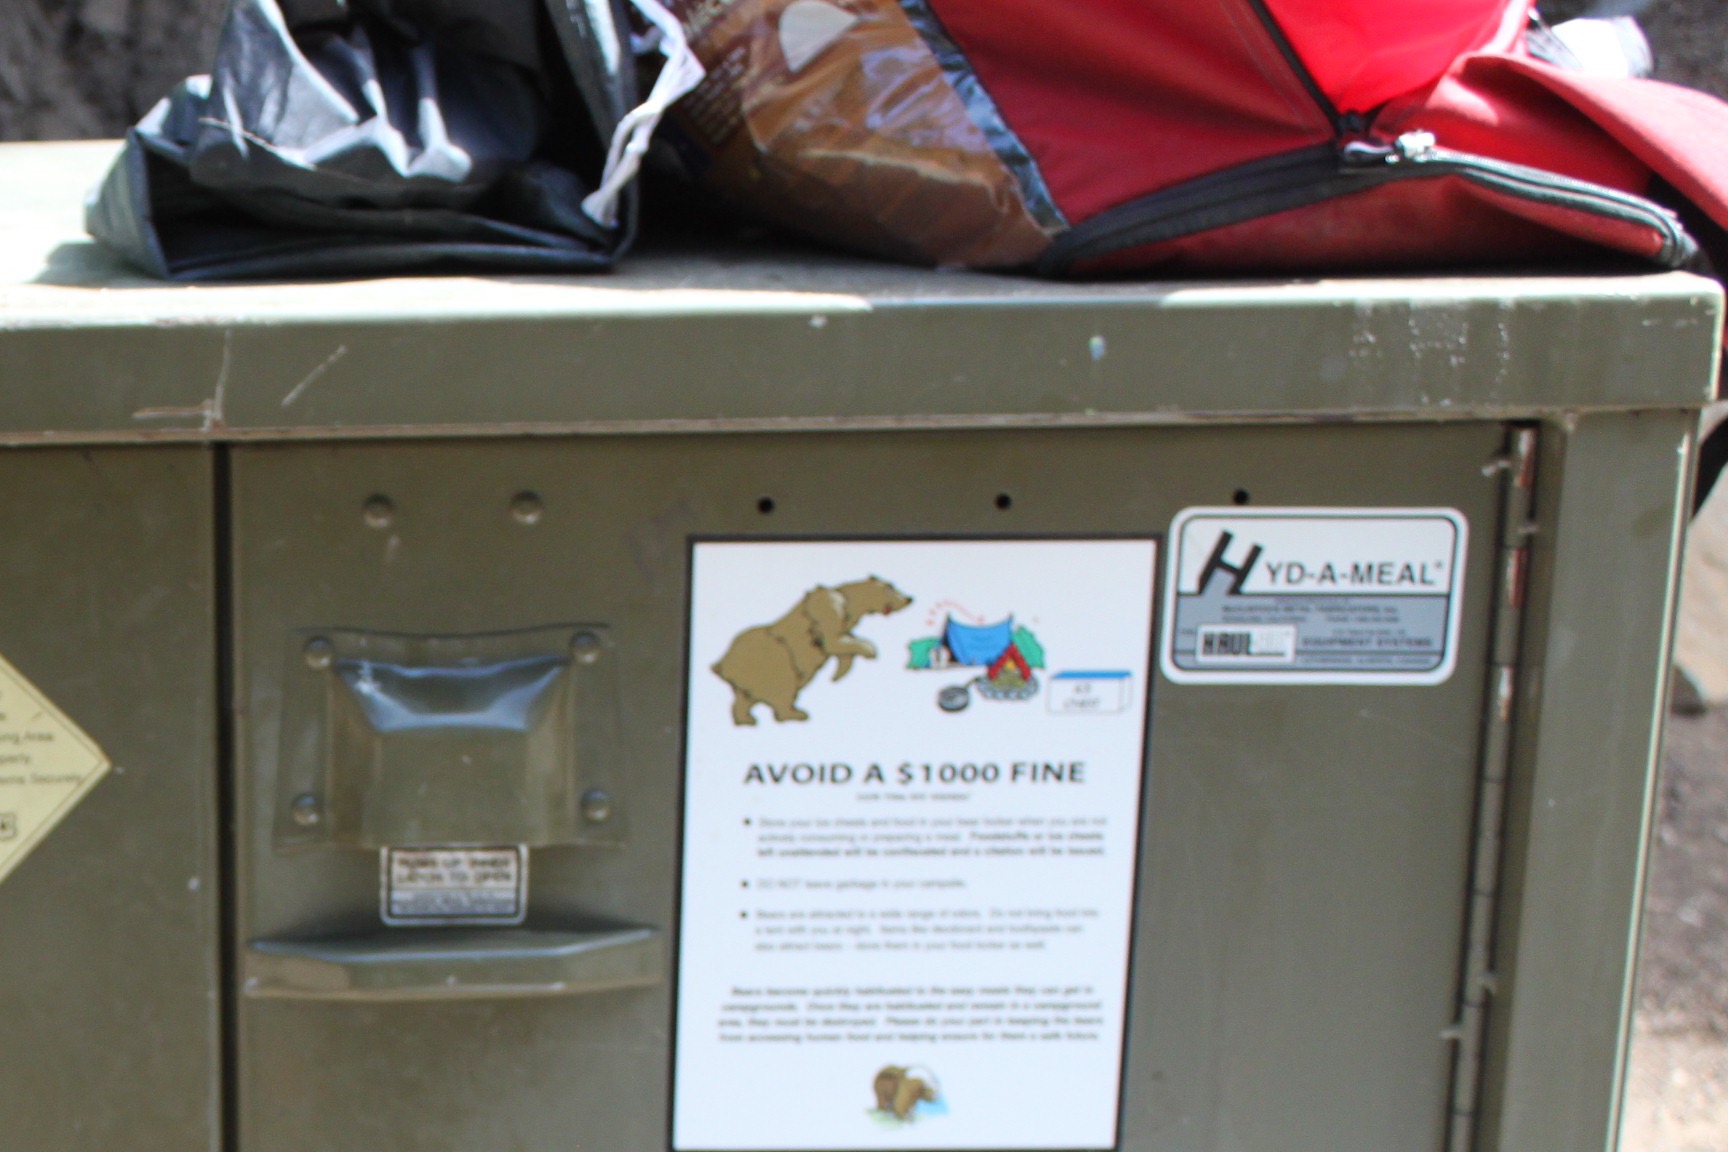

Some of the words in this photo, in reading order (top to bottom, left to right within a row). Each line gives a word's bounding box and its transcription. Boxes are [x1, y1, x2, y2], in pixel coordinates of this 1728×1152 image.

[744, 763, 853, 785] AVOID
[864, 763, 885, 783] A
[897, 760, 1000, 784] $1000
[1010, 762, 1086, 783] FINE
